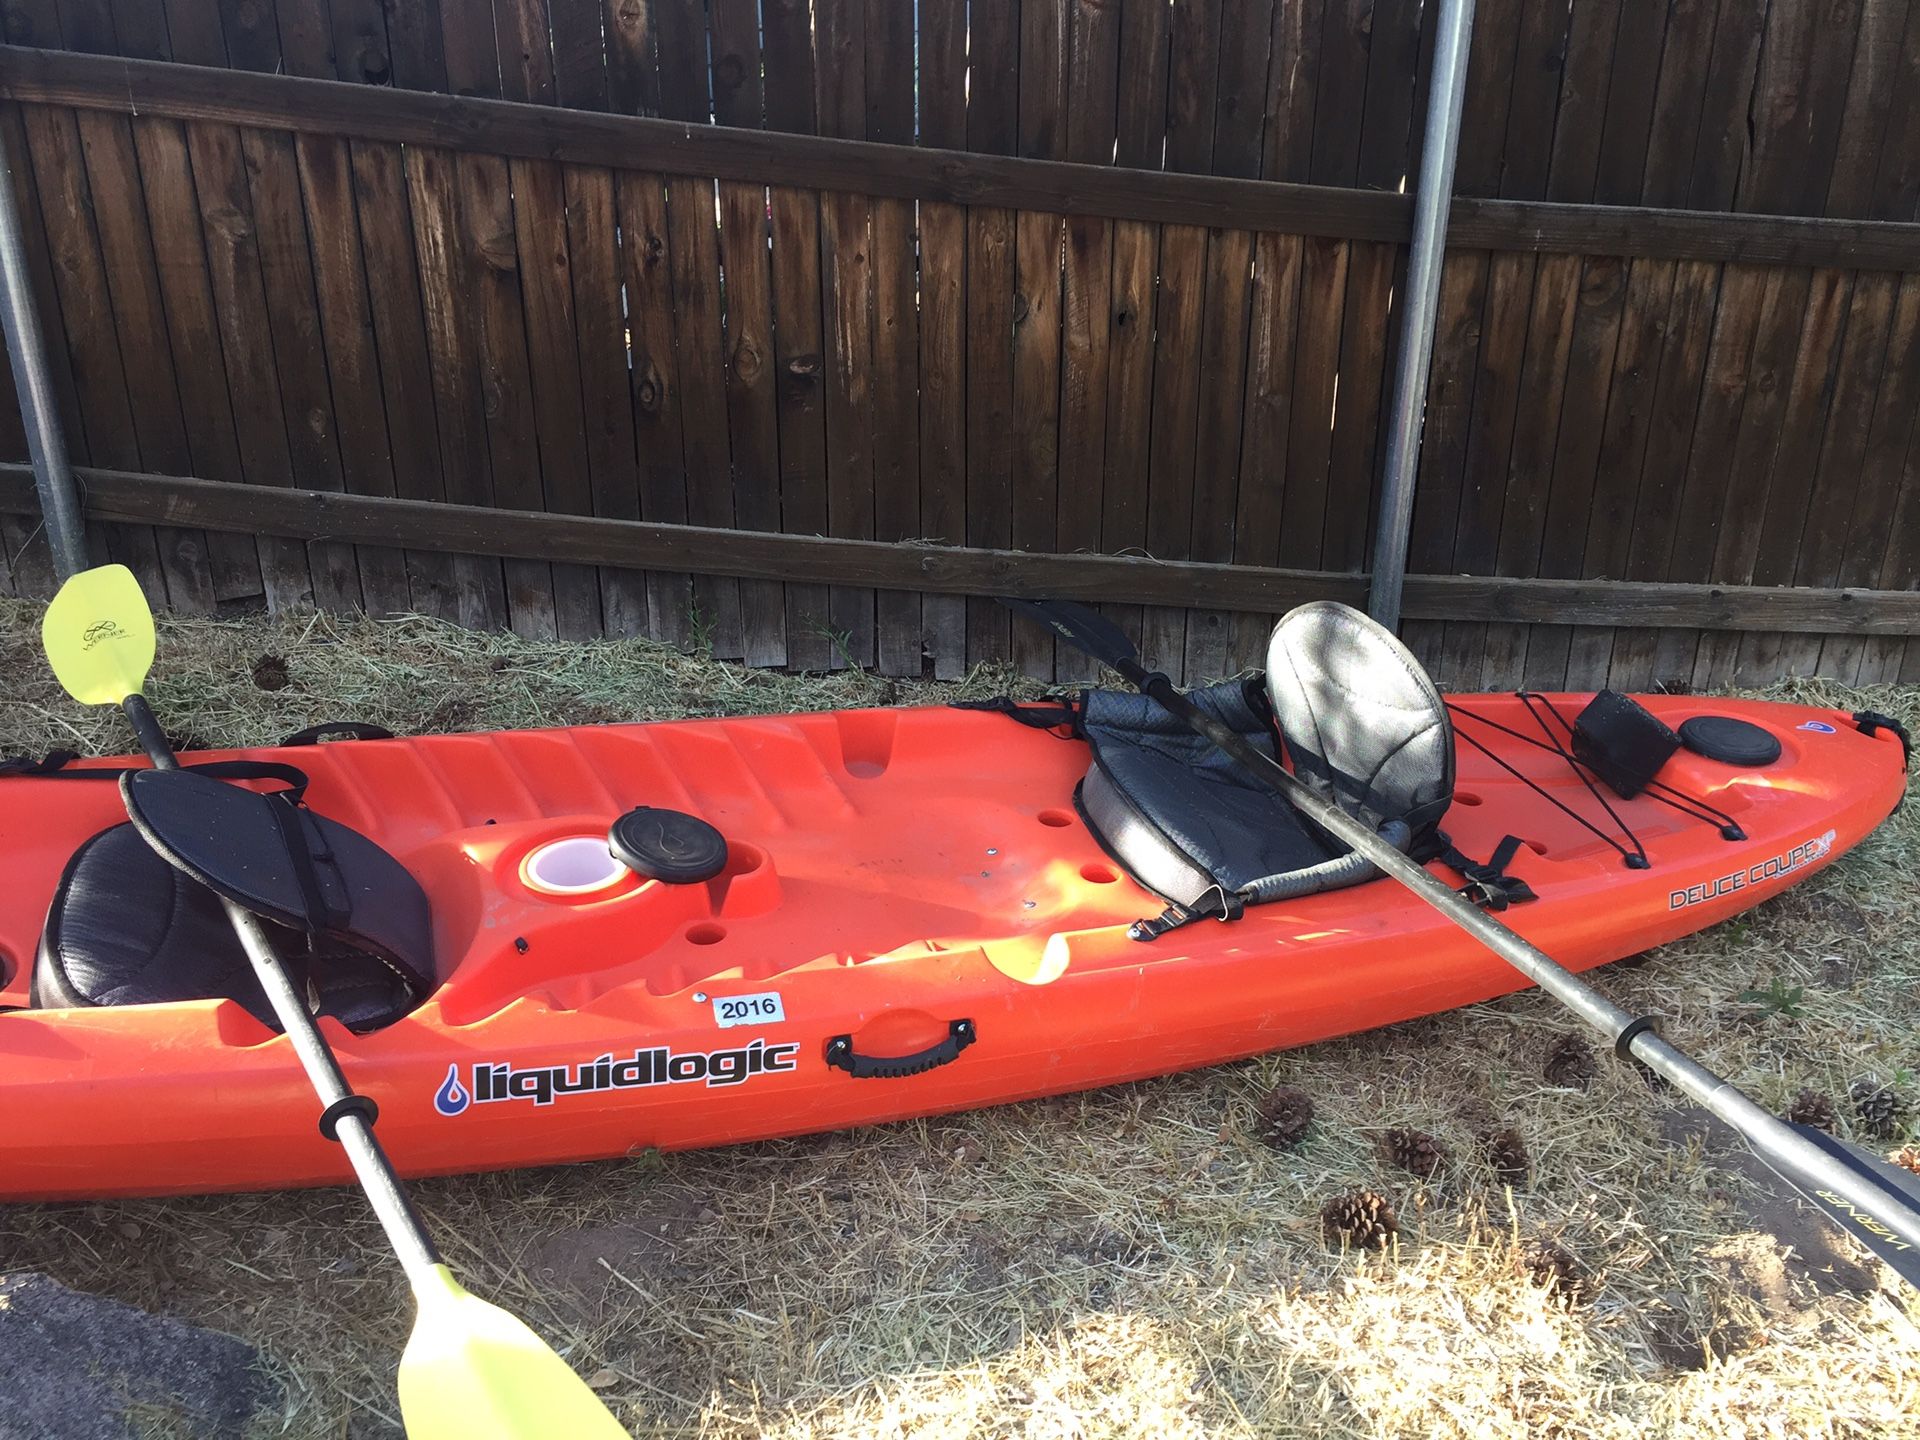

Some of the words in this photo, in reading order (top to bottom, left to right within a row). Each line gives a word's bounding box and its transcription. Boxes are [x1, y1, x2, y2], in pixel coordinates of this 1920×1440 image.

[1670, 871, 1746, 910] DEUCE
[721, 998, 776, 1019] 2016
[474, 1040, 796, 1105] liquidlogic
[1815, 1190, 1912, 1251] WERNER
